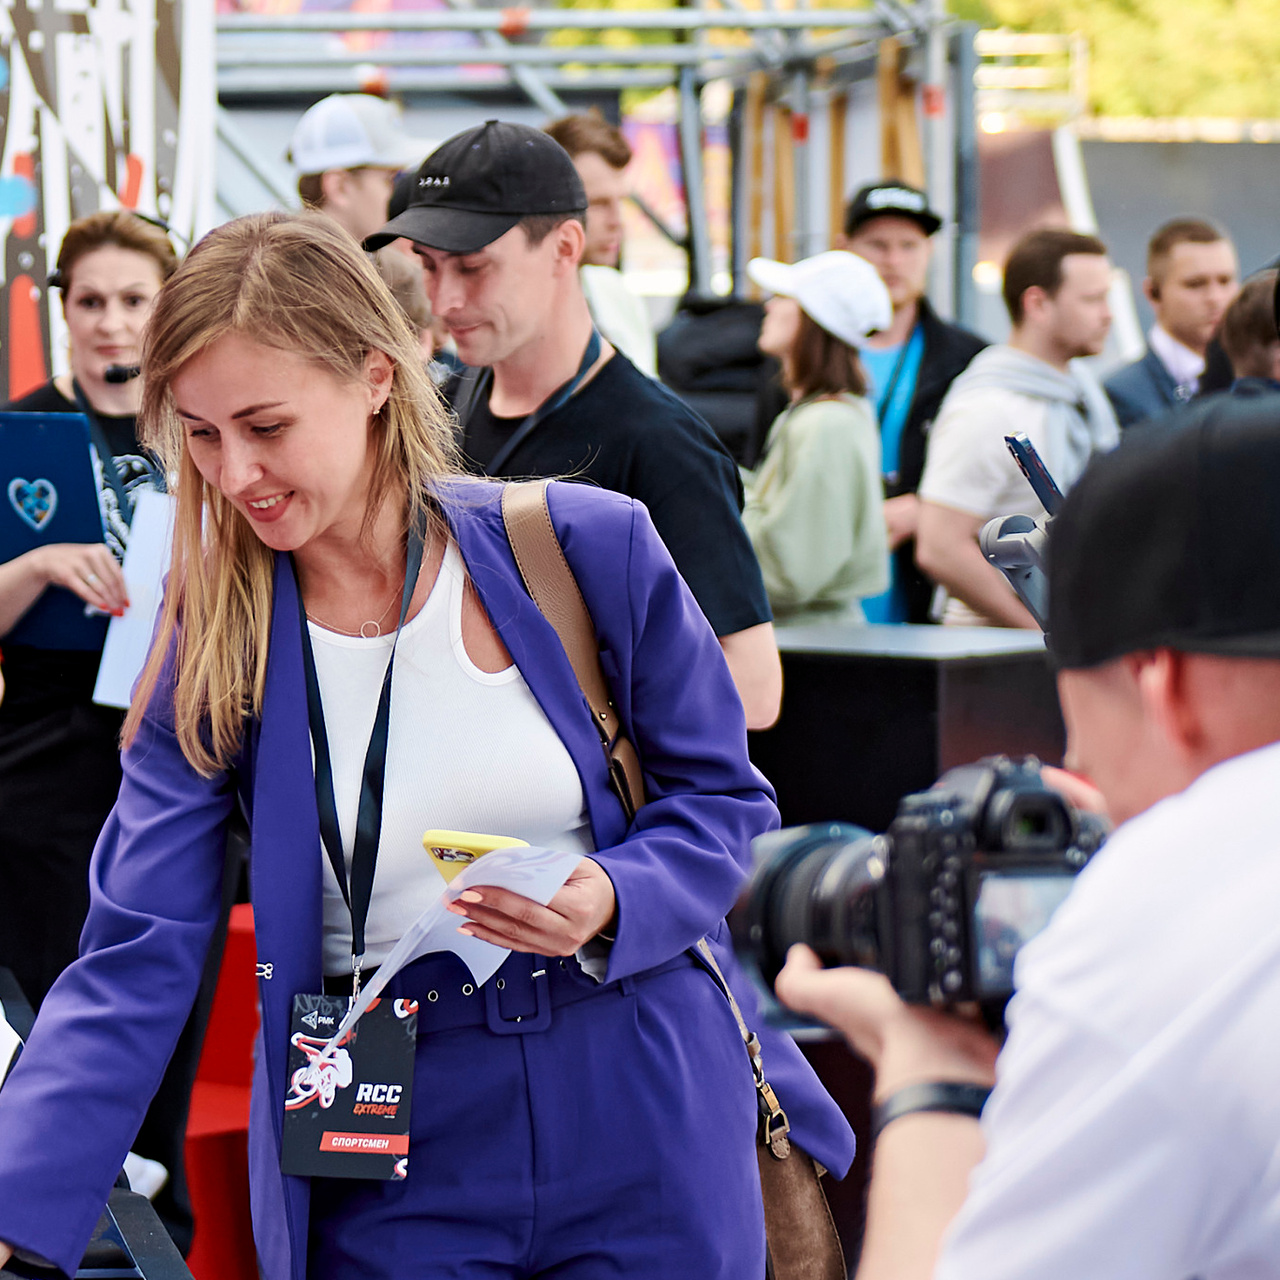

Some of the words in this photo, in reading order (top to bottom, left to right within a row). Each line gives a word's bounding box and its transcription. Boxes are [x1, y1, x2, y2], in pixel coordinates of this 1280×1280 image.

[356, 1083, 403, 1103] RCC
[353, 1103, 399, 1116] EXTREME
[331, 1137, 390, 1149] СПОРТСМЕН
